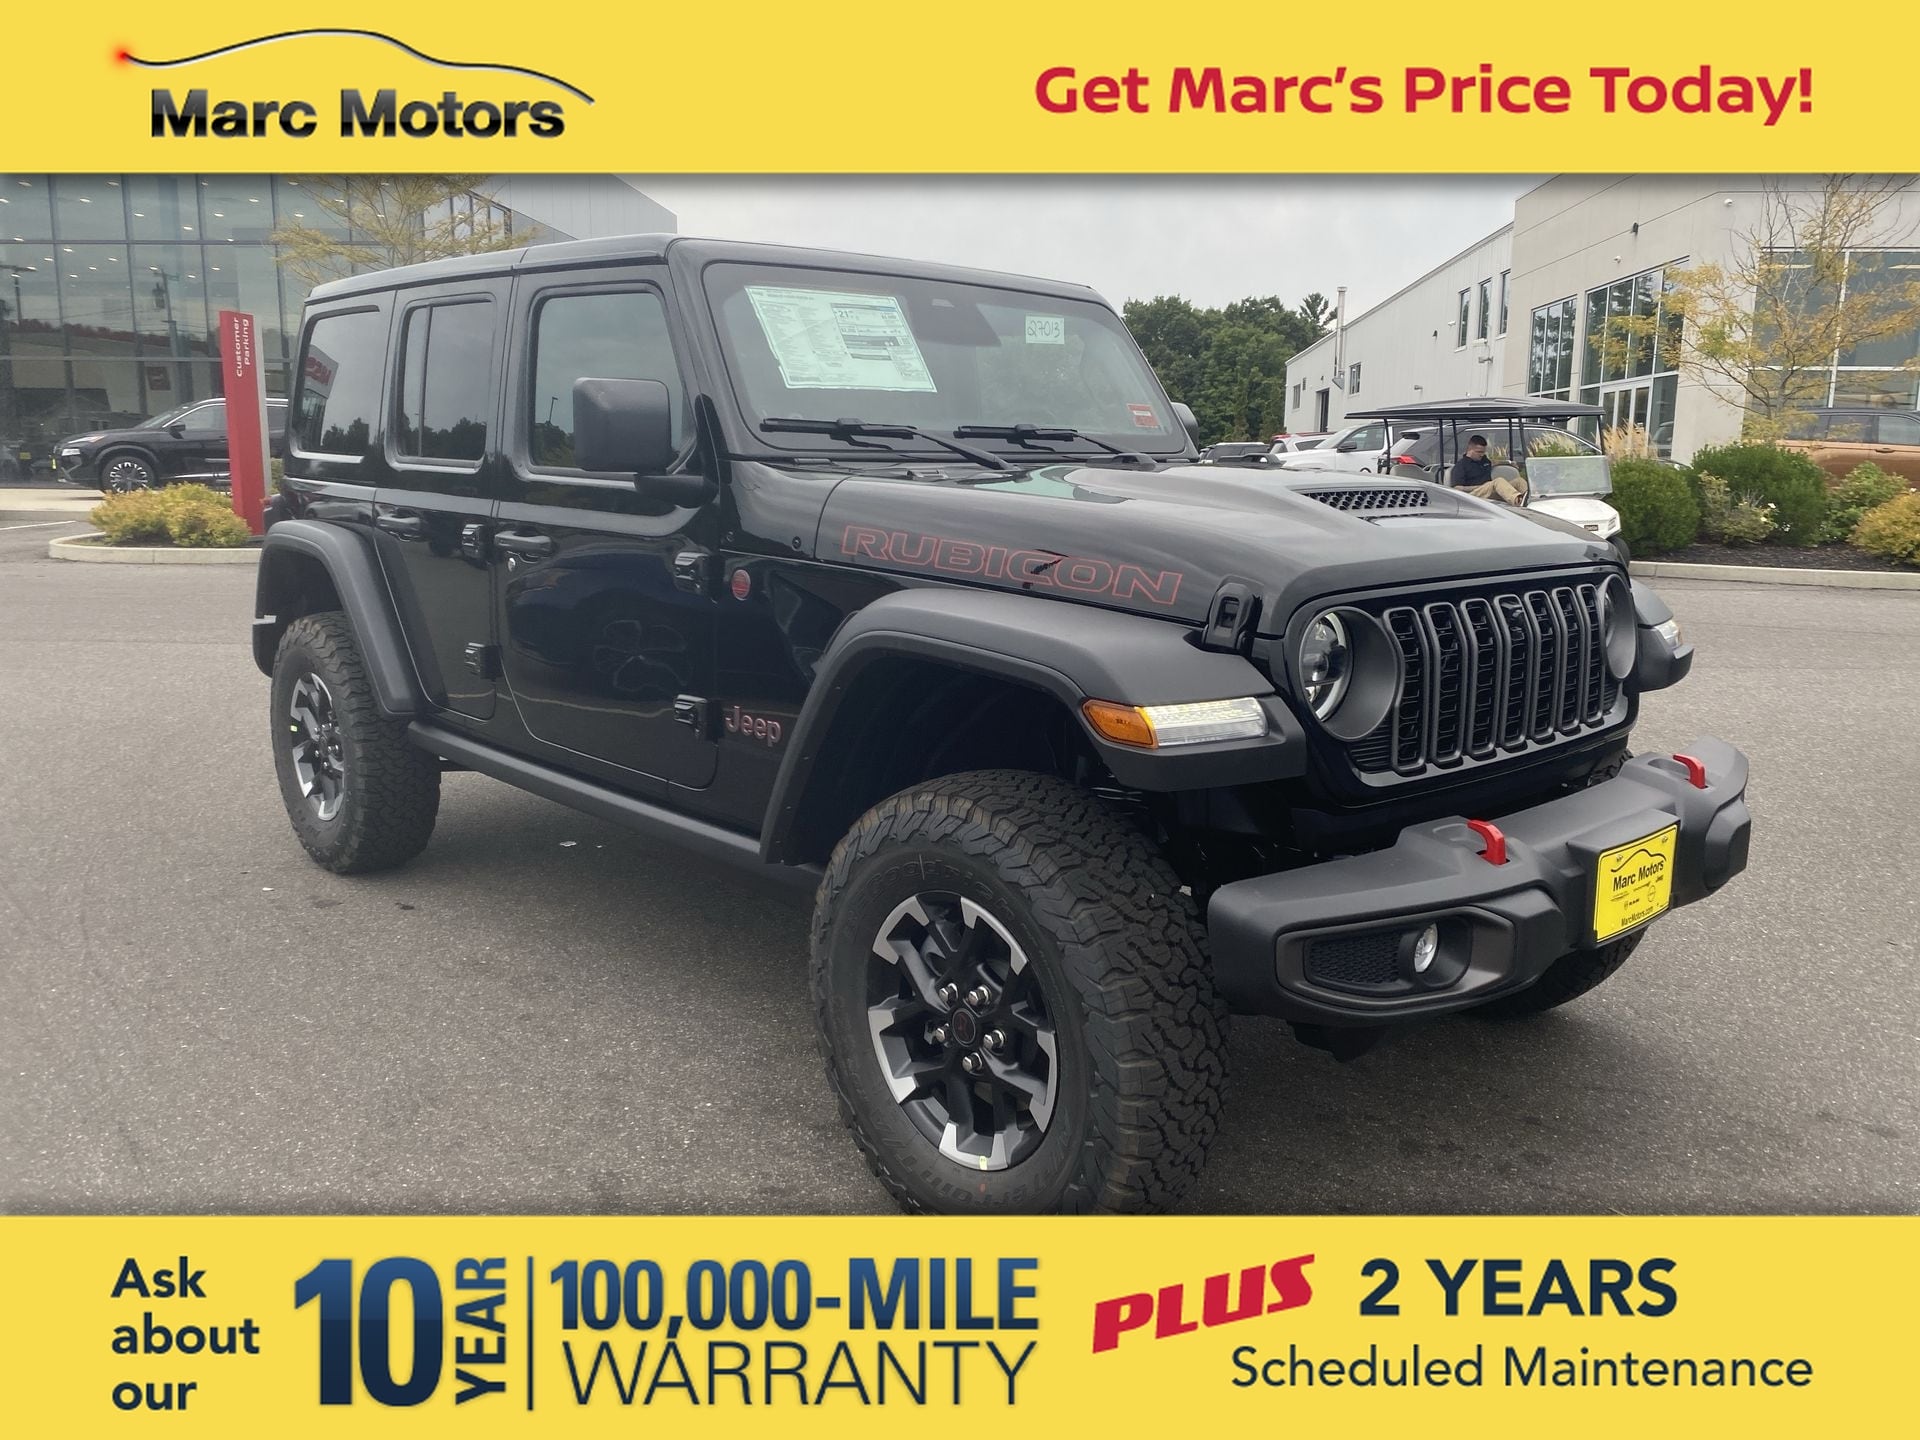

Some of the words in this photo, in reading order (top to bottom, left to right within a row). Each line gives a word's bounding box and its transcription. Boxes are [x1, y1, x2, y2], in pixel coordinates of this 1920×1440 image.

[233, 316, 243, 377] Customer
[841, 524, 1183, 606] RUBICON
[725, 705, 782, 748] Jeep
[1613, 873, 1636, 890] Marc
[1638, 860, 1664, 881] Motors
